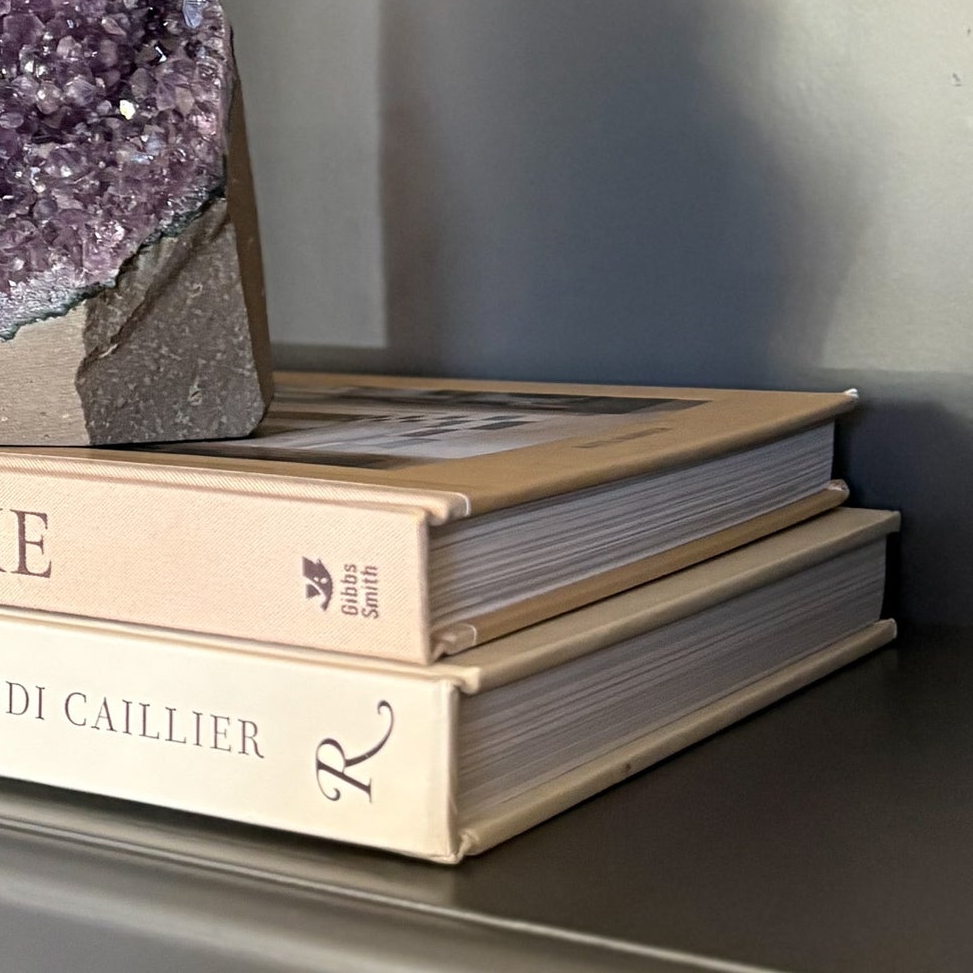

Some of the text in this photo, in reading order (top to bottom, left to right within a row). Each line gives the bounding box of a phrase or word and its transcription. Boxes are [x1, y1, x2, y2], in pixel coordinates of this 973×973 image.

[340, 563, 359, 616] Gibbs
[361, 565, 379, 619] Smith
[64, 692, 265, 759] CAILLIER
[315, 699, 394, 803] R
